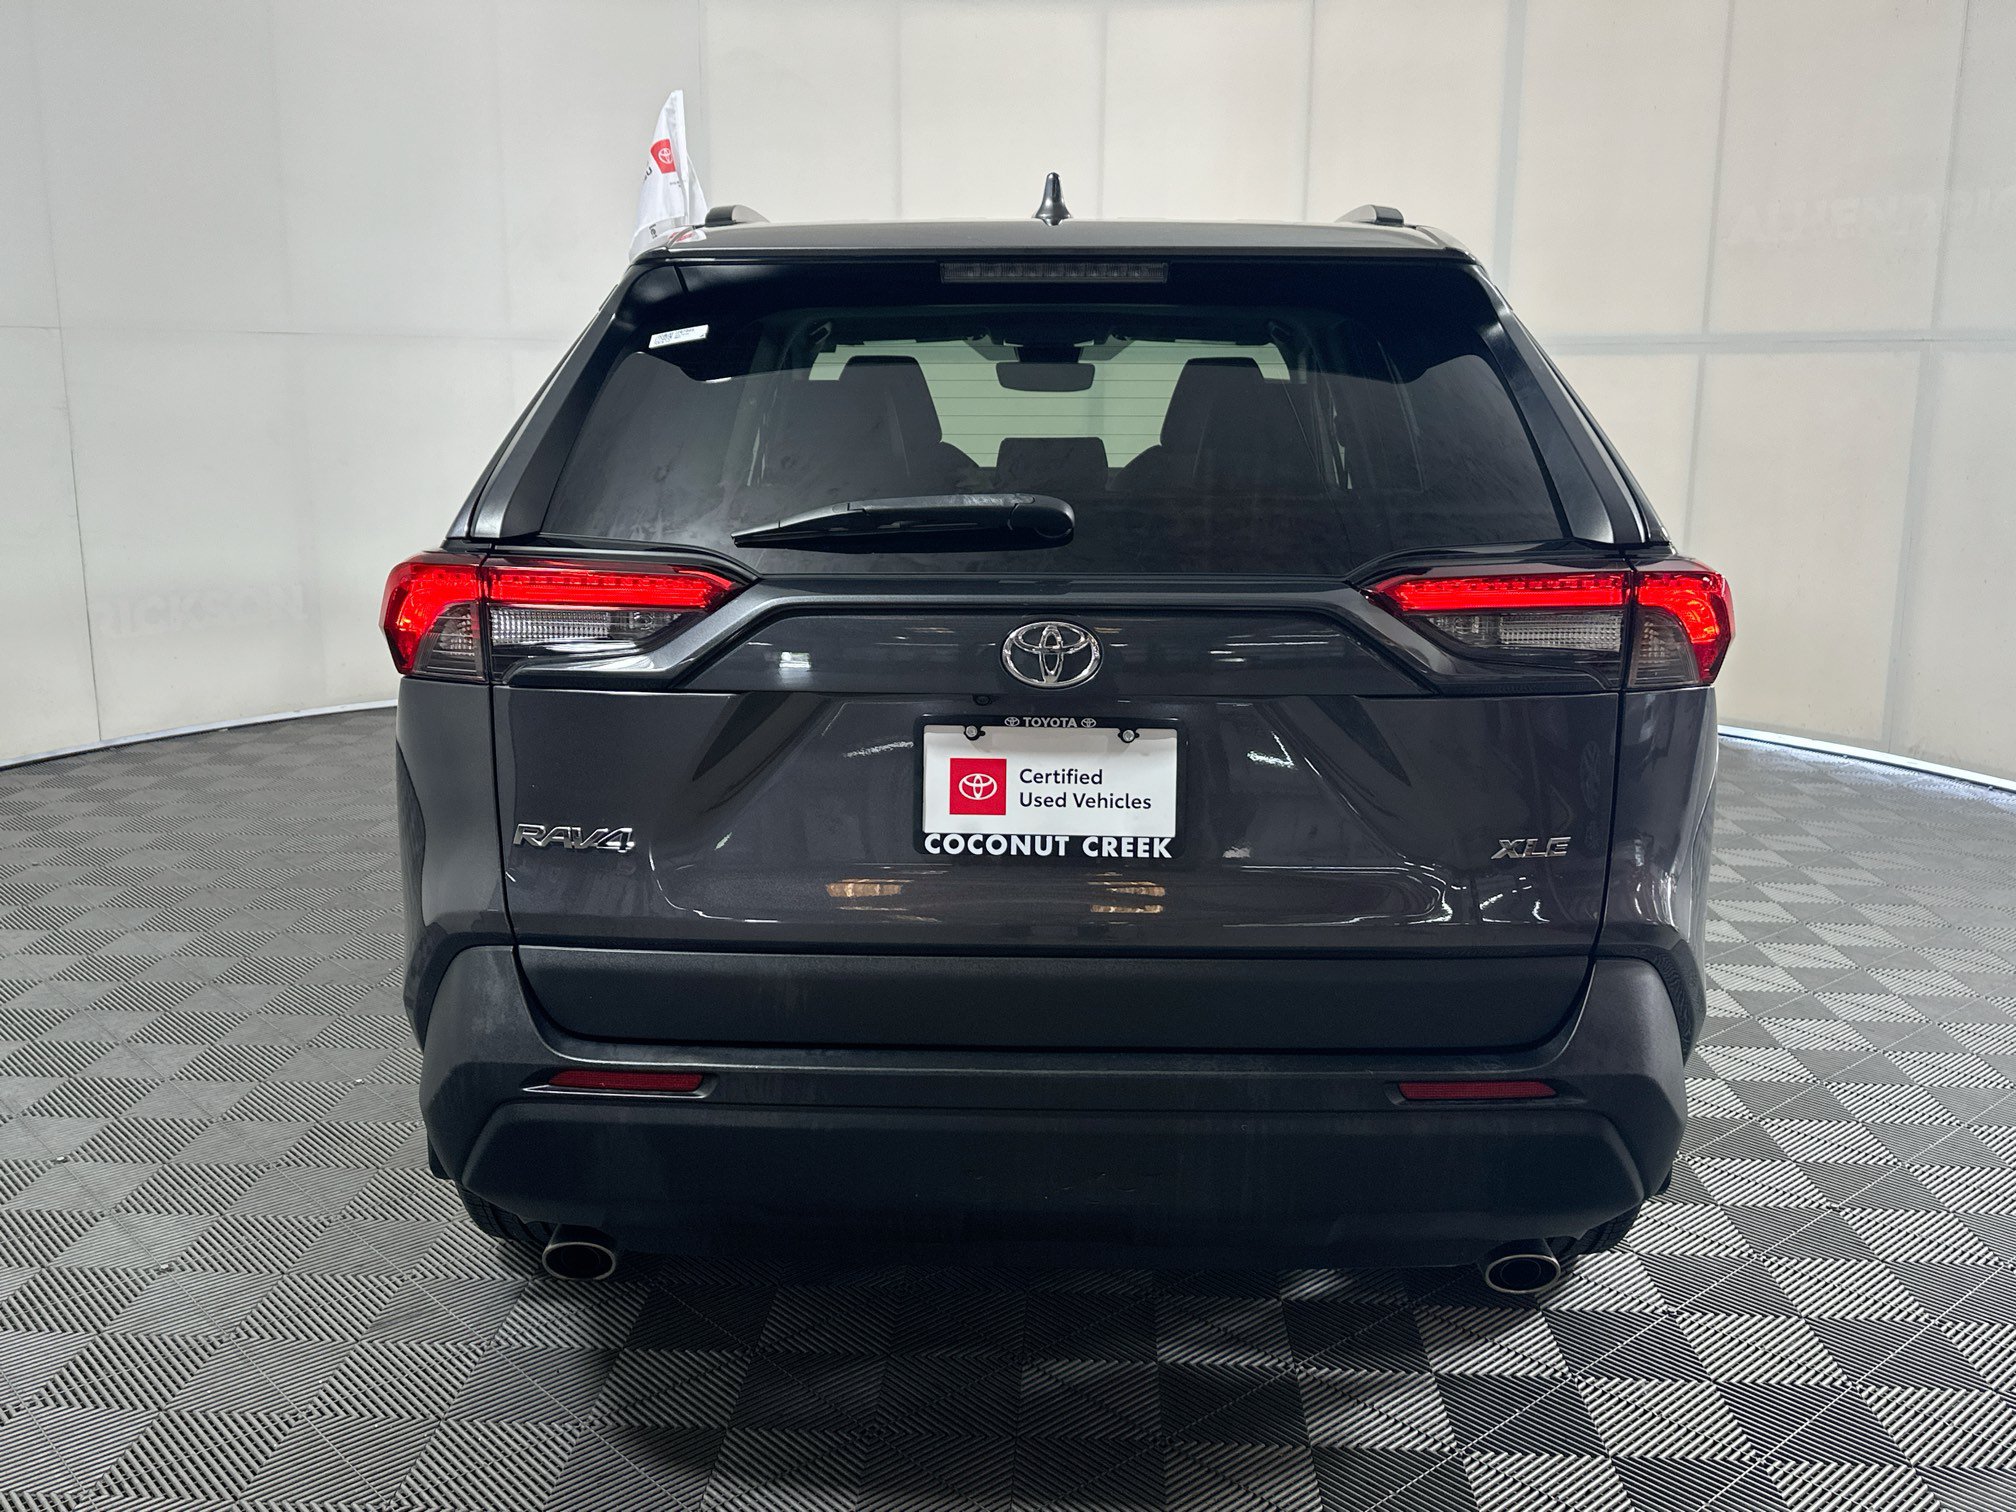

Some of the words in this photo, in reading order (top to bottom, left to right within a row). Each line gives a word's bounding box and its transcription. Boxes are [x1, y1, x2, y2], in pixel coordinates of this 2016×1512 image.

[1023, 716, 1078, 729] TOYOTA
[1019, 768, 1103, 786] Certified
[1019, 791, 1068, 809] Used
[1072, 791, 1152, 810] Vehicles
[513, 823, 636, 853] RAV4
[924, 833, 1070, 857] COCONUT
[1082, 836, 1173, 859] CREEK
[1490, 836, 1572, 859] XLE
